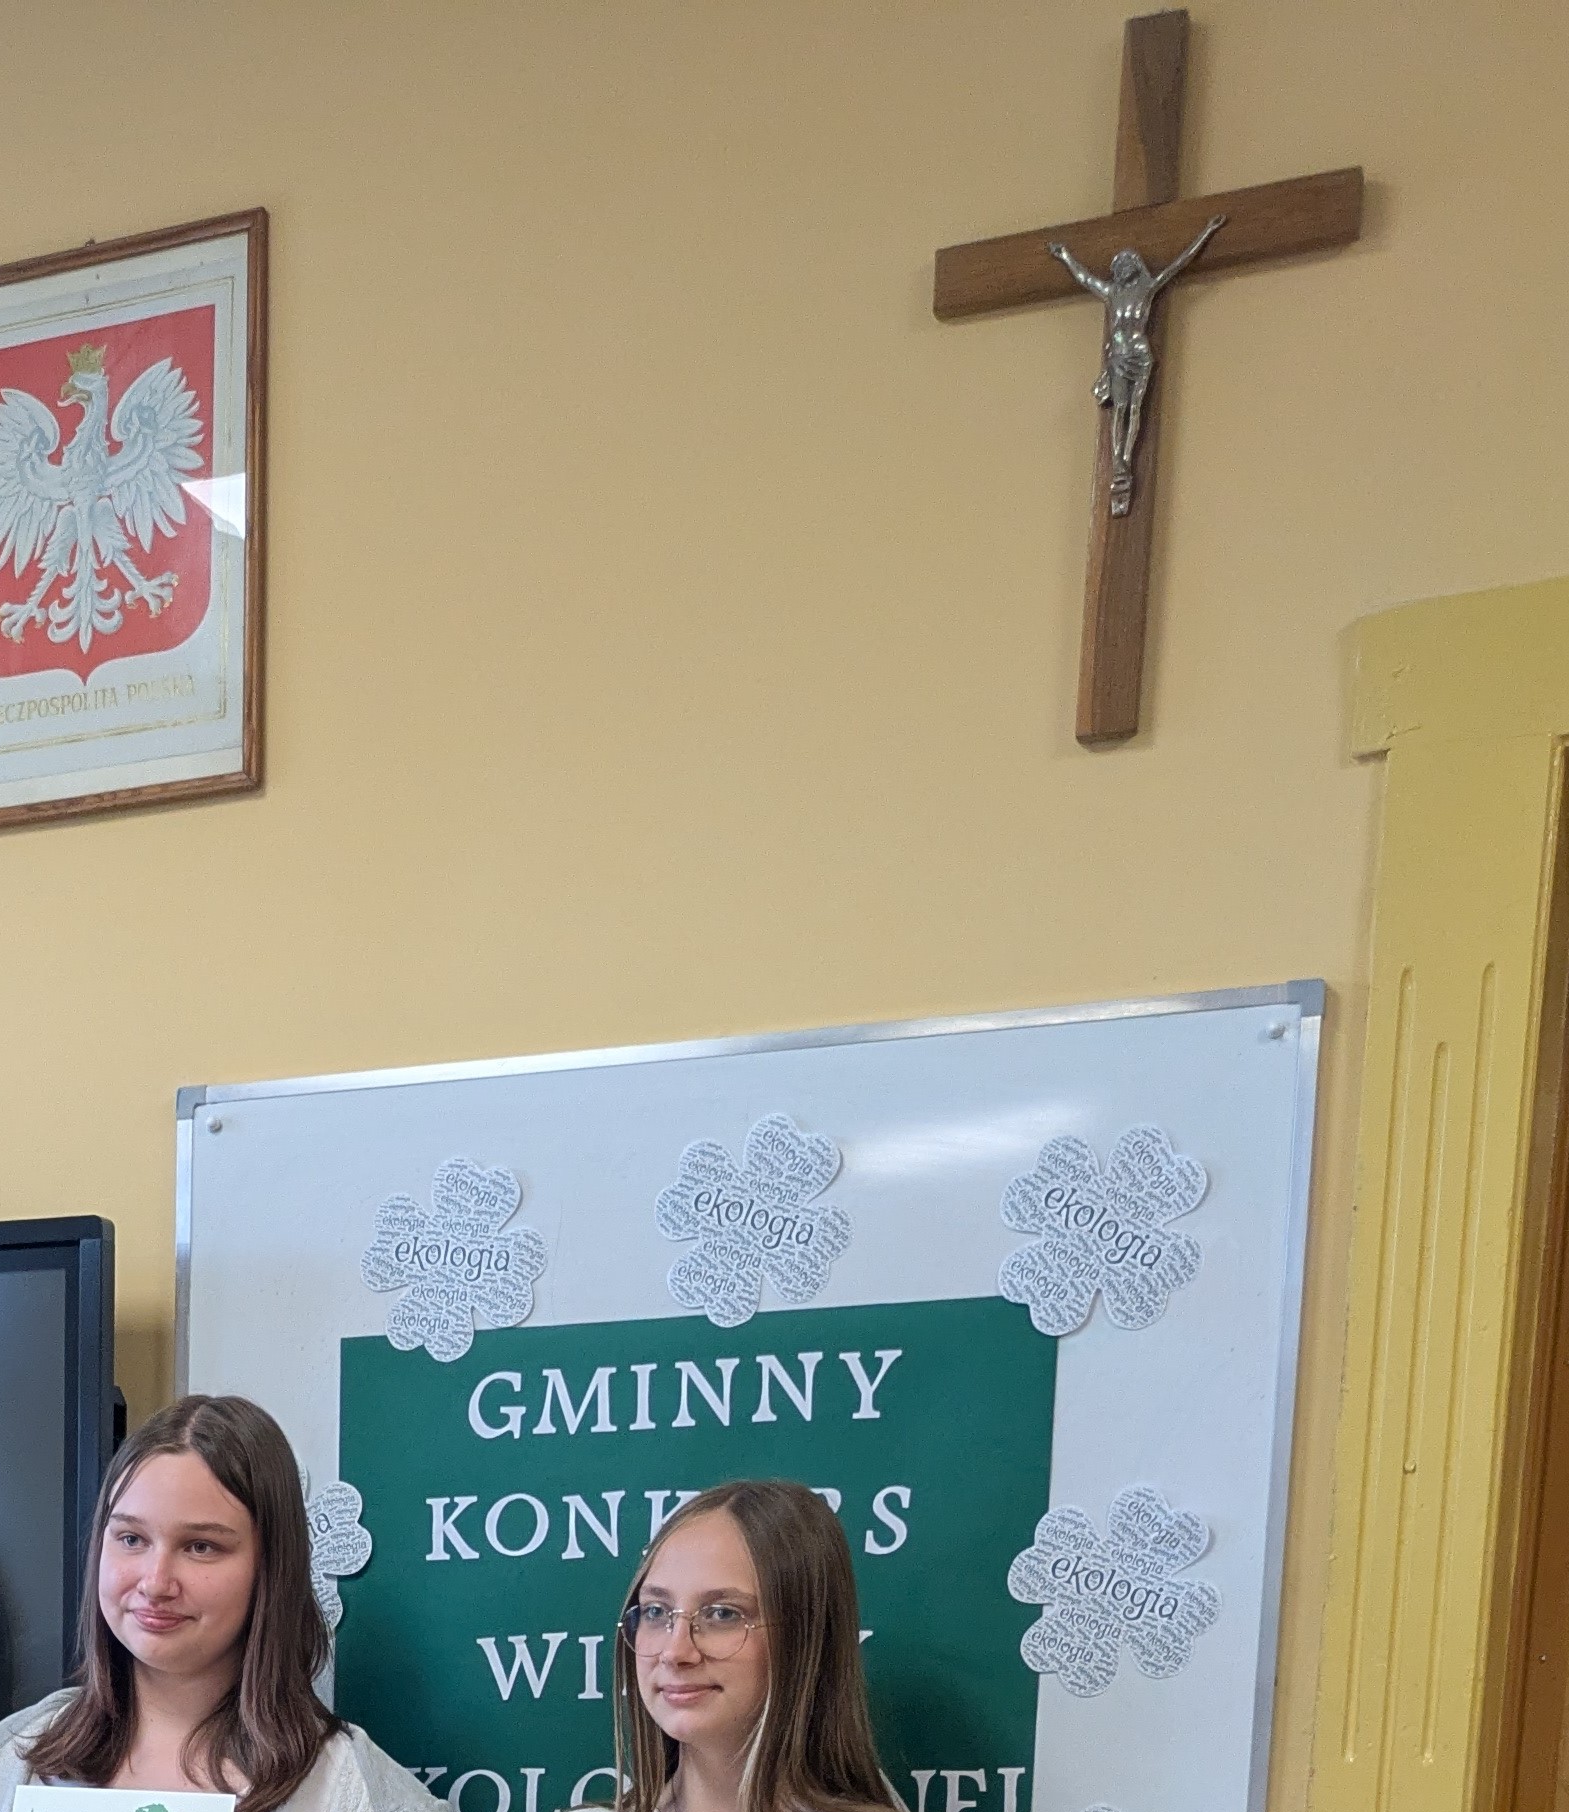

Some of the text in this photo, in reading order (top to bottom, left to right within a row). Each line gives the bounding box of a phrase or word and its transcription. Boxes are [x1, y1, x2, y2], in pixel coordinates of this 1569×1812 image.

[693, 1188, 814, 1250] ekologia
[1044, 1186, 1162, 1270] ekologia
[394, 1236, 510, 1282] ekologia
[467, 1349, 903, 1440] GMINNY
[425, 1485, 912, 1562] KONKS
[1051, 1556, 1179, 1622] ekologia
